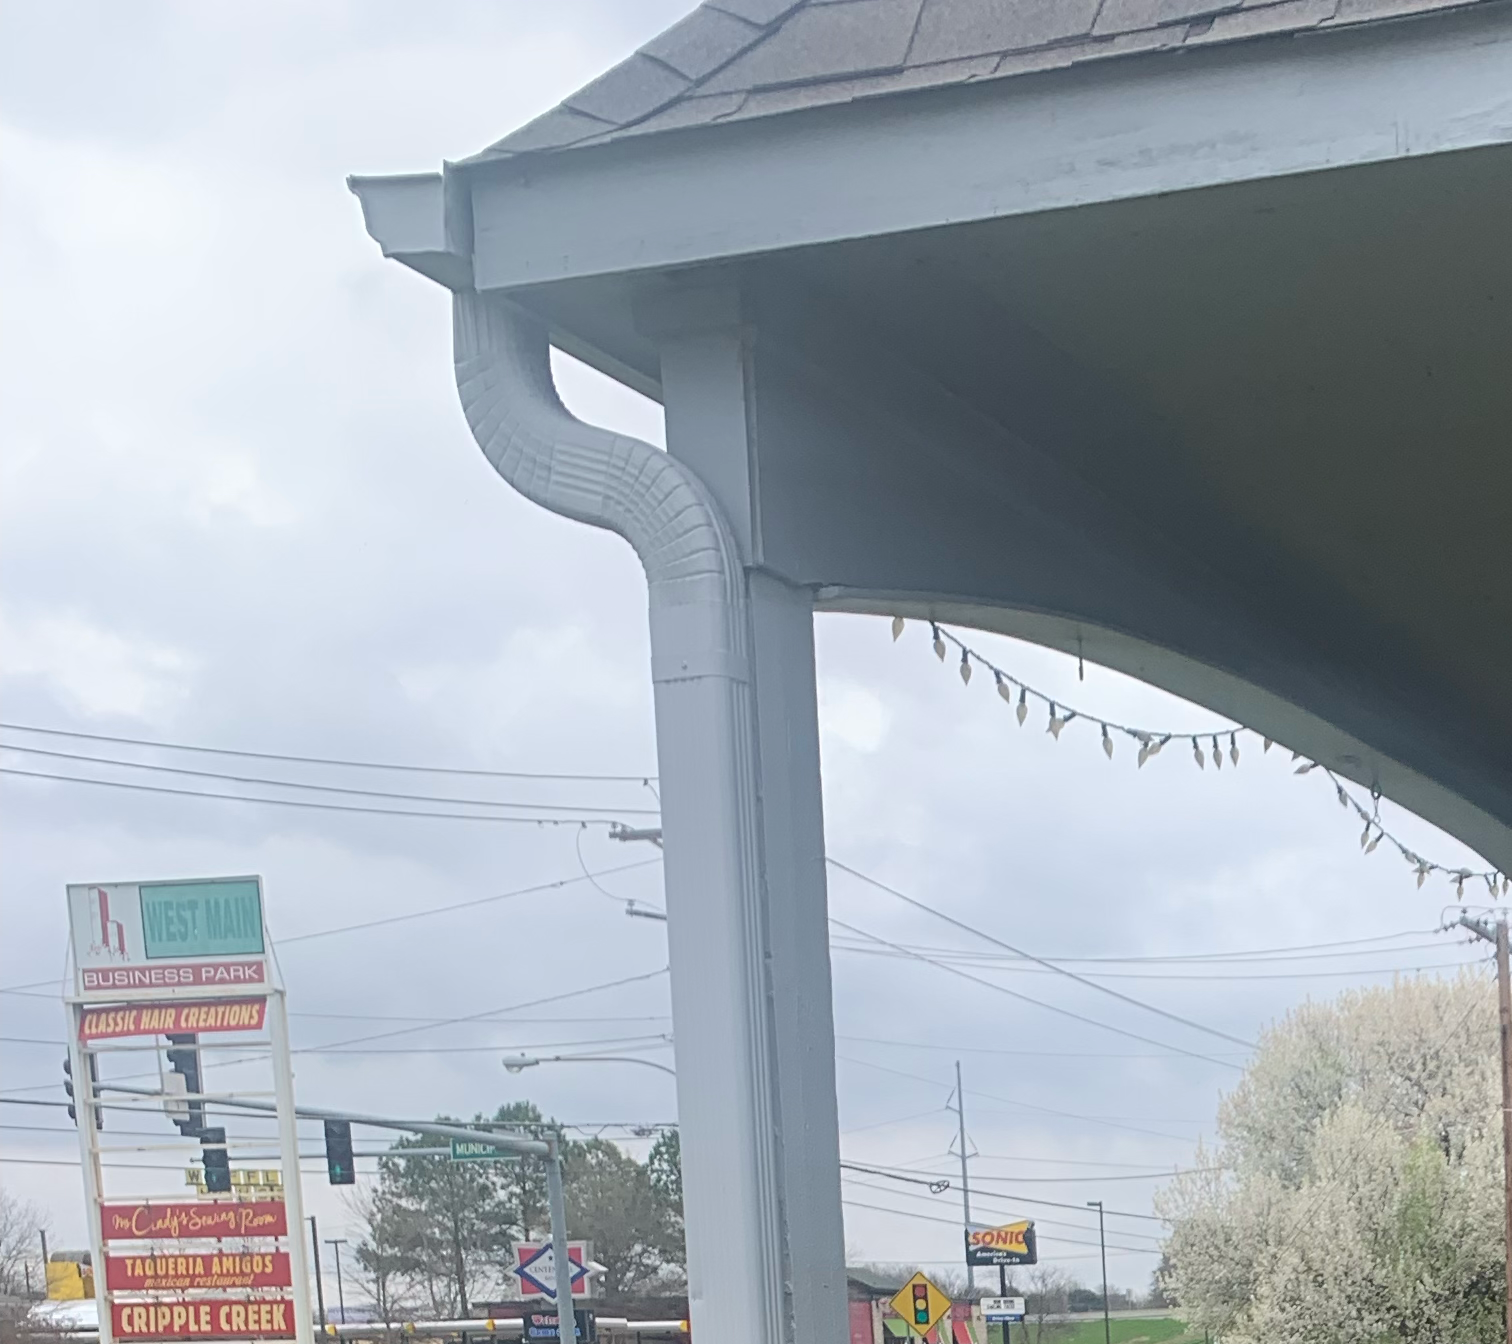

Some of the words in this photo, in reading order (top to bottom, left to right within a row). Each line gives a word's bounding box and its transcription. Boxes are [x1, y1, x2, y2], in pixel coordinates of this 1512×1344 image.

[144, 898, 199, 943] WEST
[204, 896, 257, 940] MAIN
[84, 967, 194, 987] BUSINESS
[202, 964, 259, 982] PARK
[84, 1009, 137, 1035] CLASSIC
[140, 1007, 176, 1030] HAIR
[180, 1003, 260, 1029] CREATIONS
[238, 1207, 277, 1235] Room
[972, 1231, 1024, 1246] SONIC
[125, 1256, 204, 1277] TAQUERIA
[211, 1255, 273, 1274] AMIGOS
[144, 1275, 190, 1288] mexican
[194, 1274, 254, 1287] restaurant
[121, 1304, 212, 1333] CRIPPLE
[219, 1303, 287, 1332] CREEK
